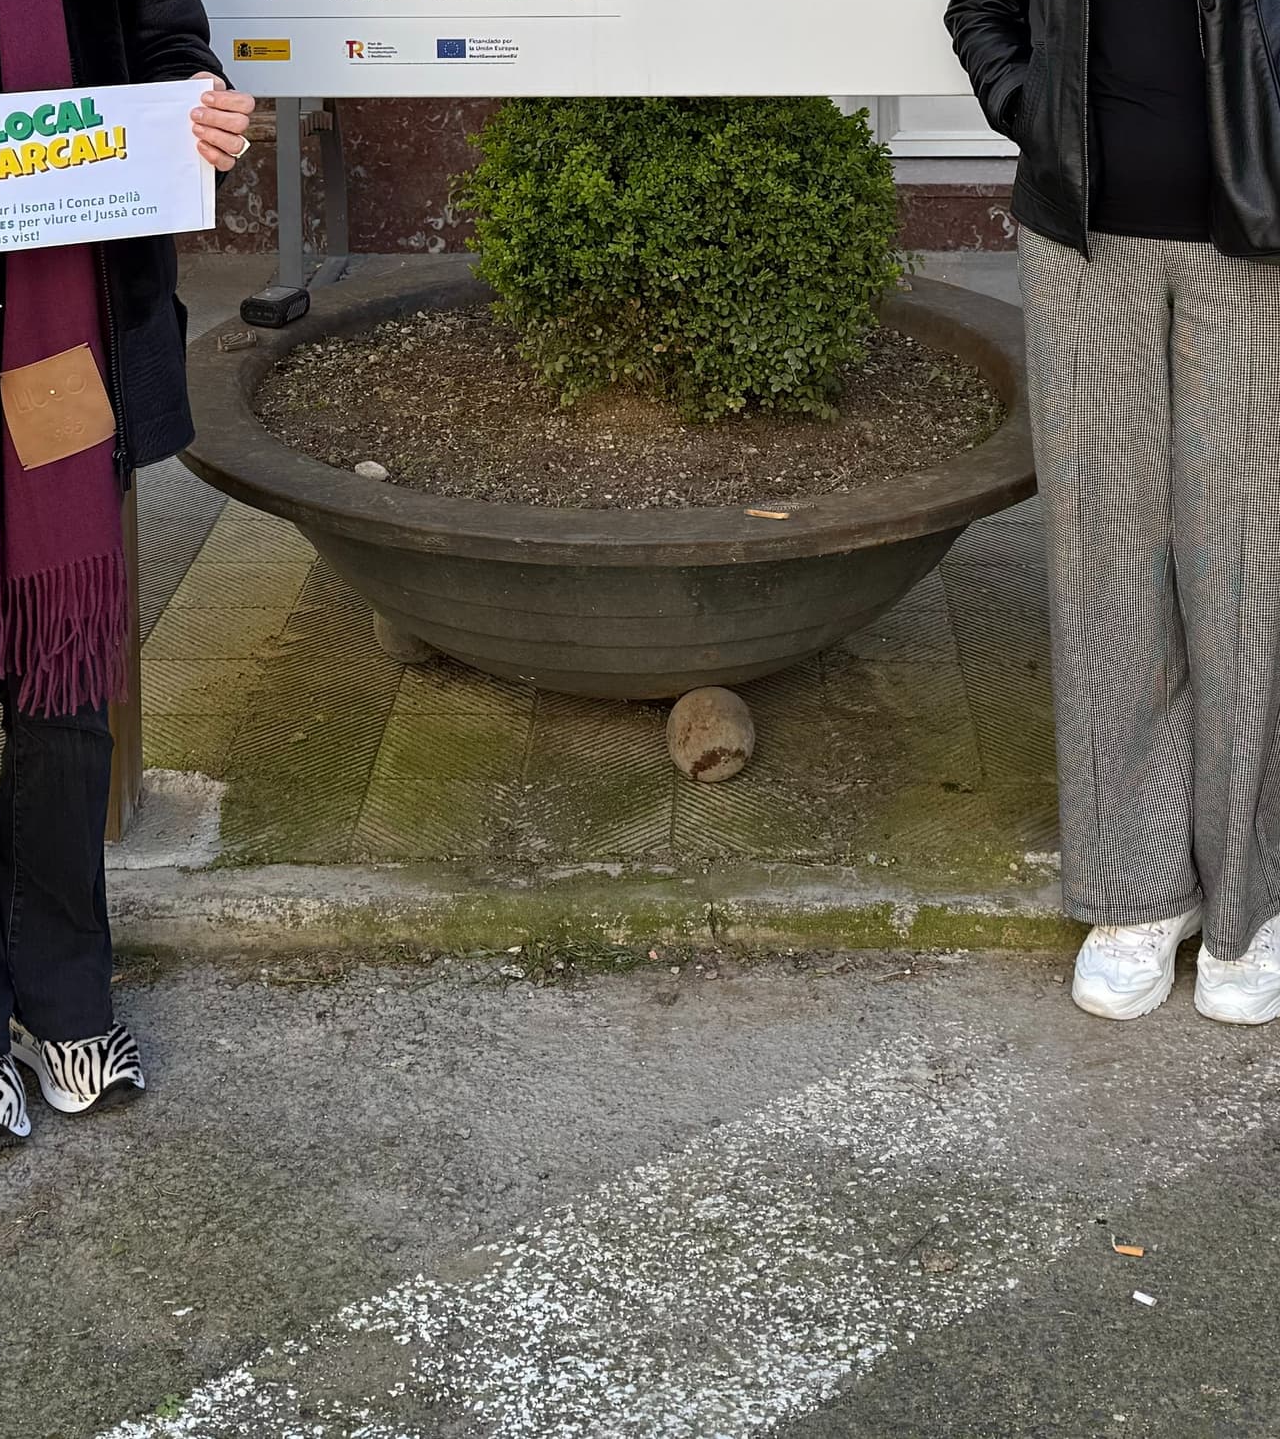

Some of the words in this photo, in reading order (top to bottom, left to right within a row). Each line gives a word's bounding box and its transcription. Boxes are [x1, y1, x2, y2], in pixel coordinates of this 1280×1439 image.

[20, 201, 56, 214] Isona
[66, 197, 106, 210] Conca
[18, 216, 41, 231] per
[43, 211, 78, 226] viure
[80, 209, 92, 222] el
[94, 206, 128, 223] Jussà
[131, 204, 158, 217] com
[11, 230, 41, 244] vist!
